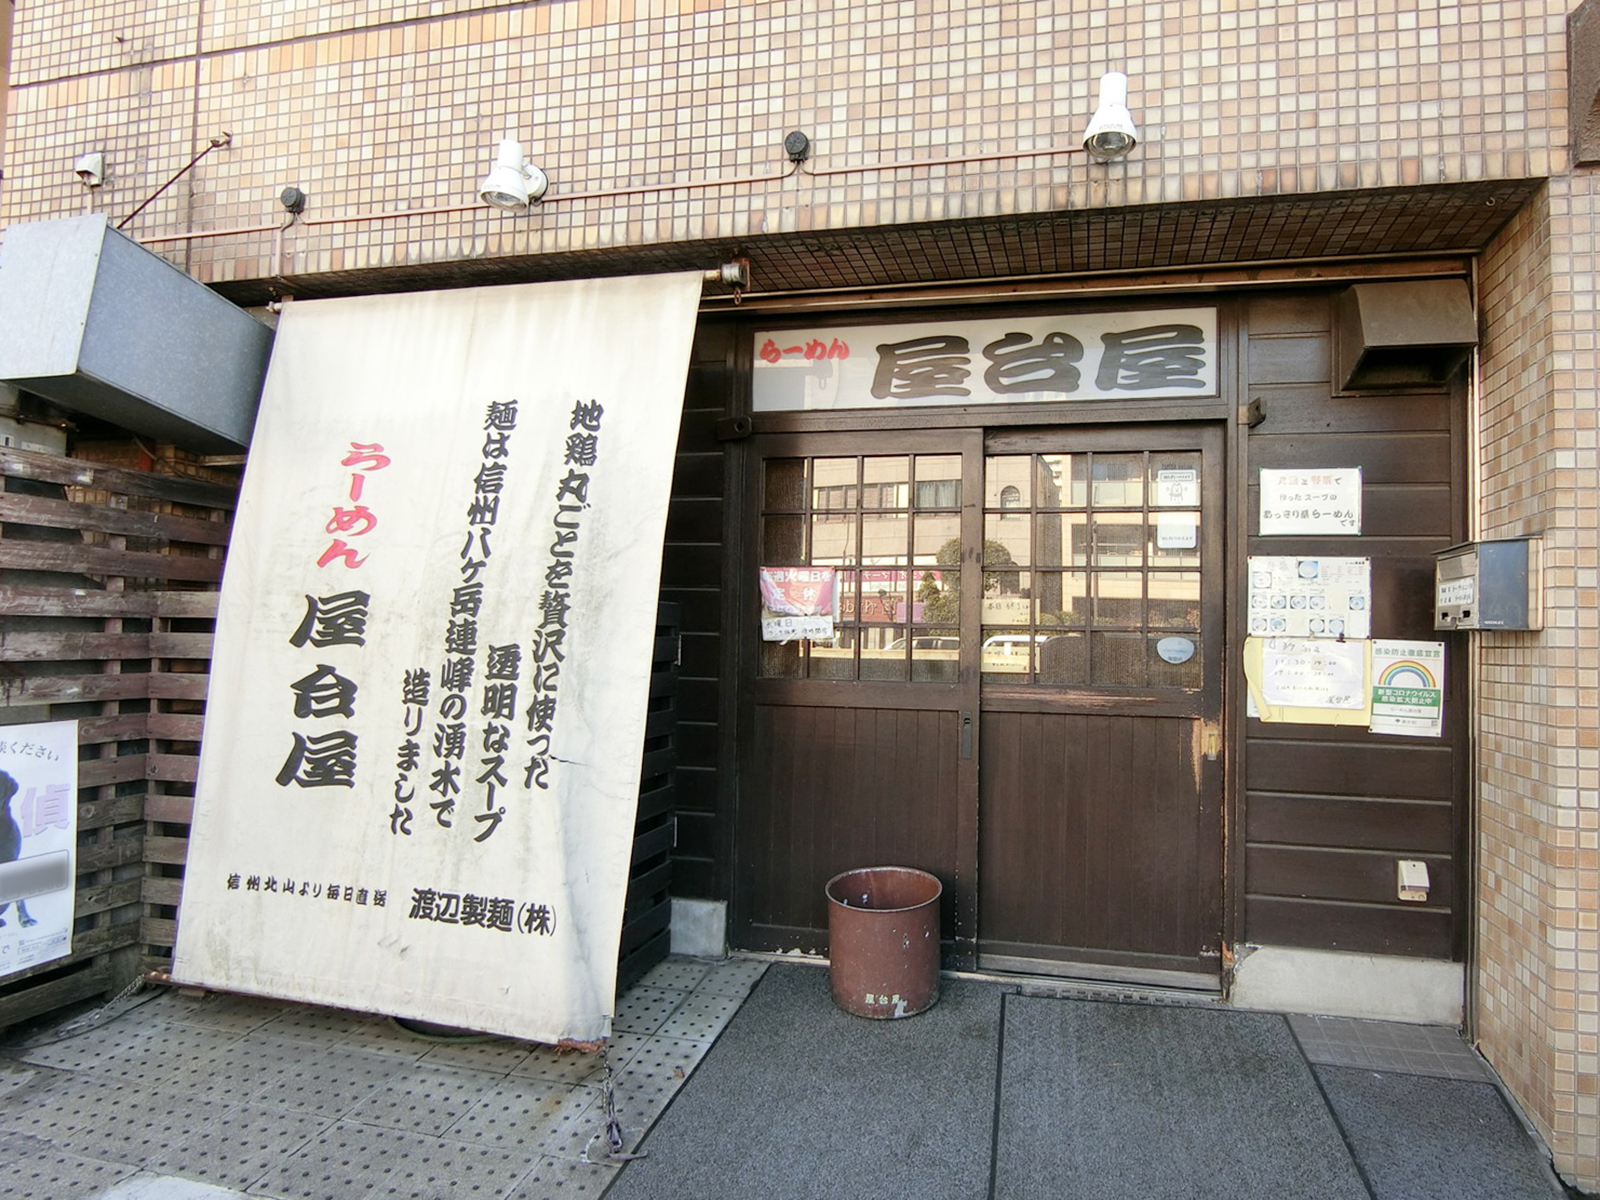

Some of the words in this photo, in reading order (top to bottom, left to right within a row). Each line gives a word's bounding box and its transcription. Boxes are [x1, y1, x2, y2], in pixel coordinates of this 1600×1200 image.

[759, 337, 850, 364] らーめん
[869, 323, 1207, 399] 屋台屋
[317, 441, 391, 569] らーめん
[524, 399, 603, 789] 地鶏丸ごとを贅沢に使った
[275, 590, 371, 789] 屋台屋
[389, 668, 430, 835] 造りました
[473, 643, 520, 842] 透明なスープ
[1377, 688, 1437, 698] 新型コロナウイルス
[226, 872, 388, 908] 信州北山より毎日直送
